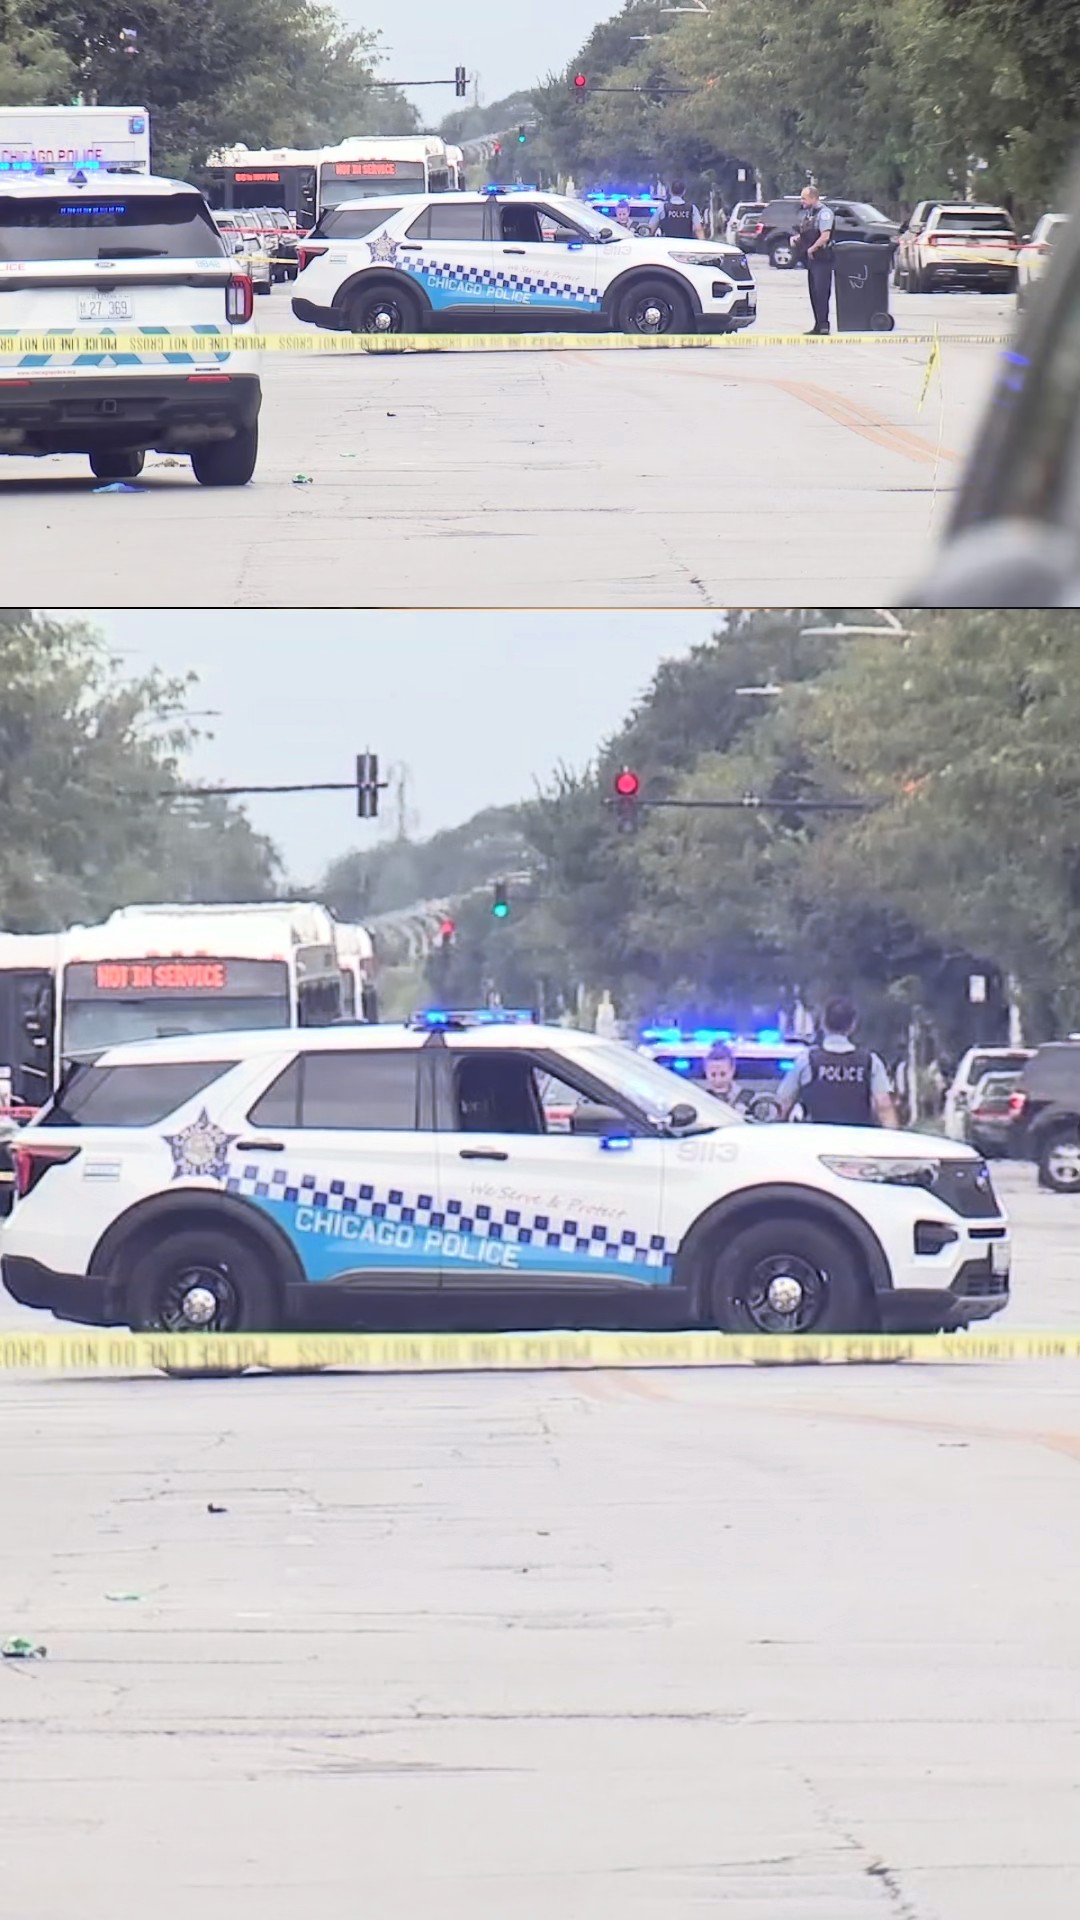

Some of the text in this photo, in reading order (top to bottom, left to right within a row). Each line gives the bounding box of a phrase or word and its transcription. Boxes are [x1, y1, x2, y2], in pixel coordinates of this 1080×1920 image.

[363, 162, 396, 175] SERVICE
[667, 209, 690, 219] POLICE
[427, 275, 532, 305] CHICAGO POLICE
[89, 301, 102, 316] 27
[108, 300, 128, 315] 369
[19, 337, 38, 351] NOT
[42, 337, 56, 351] DO
[60, 337, 80, 351] LINE
[85, 337, 117, 351] POLICE
[129, 336, 266, 350] POLICE LINE DO NOT CROSS
[278, 336, 313, 350] CROSS
[319, 336, 337, 350] NOT
[96, 963, 225, 989] NOT IN SERVICE
[818, 1064, 865, 1083] POLICE
[676, 1141, 739, 1163] 9113
[497, 1186, 541, 1204] Serve
[567, 1197, 627, 1219] Protect
[294, 1207, 523, 1269] CHICAGO POLICE
[60, 1339, 98, 1368] NOT
[109, 1339, 137, 1368] DO
